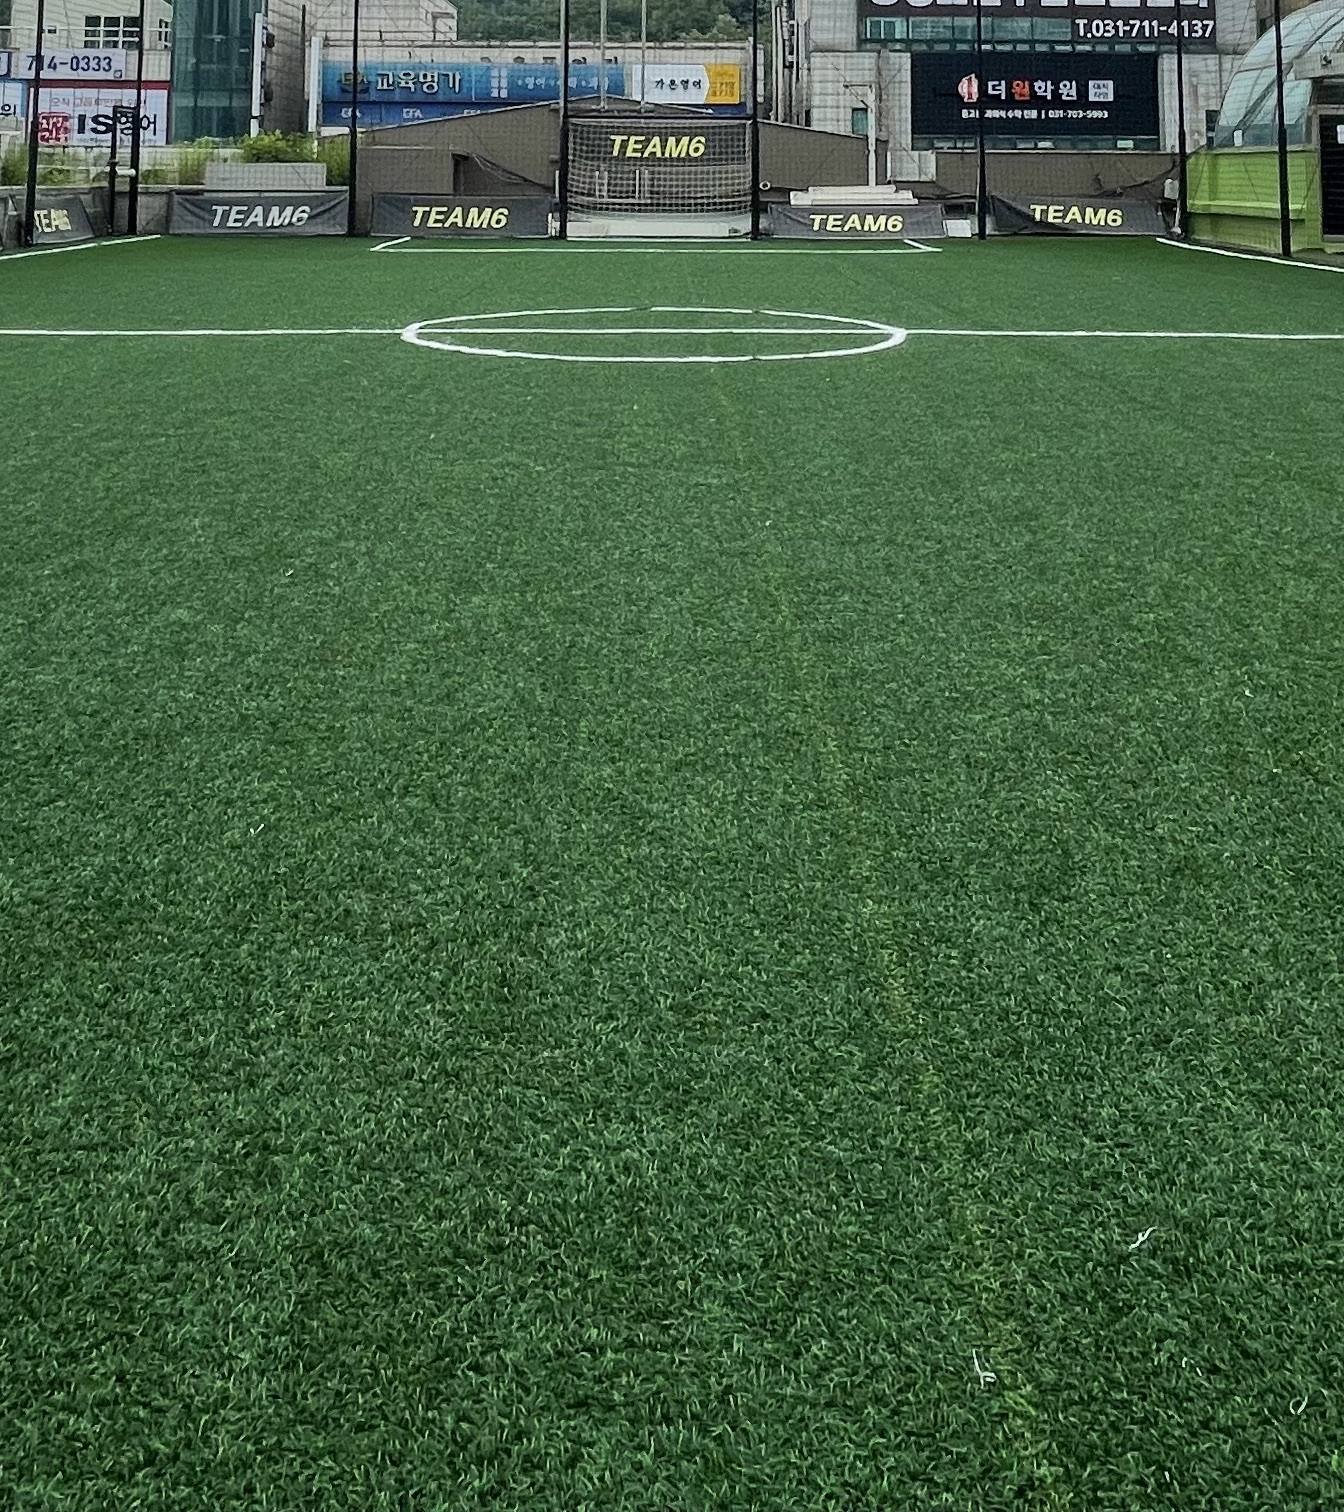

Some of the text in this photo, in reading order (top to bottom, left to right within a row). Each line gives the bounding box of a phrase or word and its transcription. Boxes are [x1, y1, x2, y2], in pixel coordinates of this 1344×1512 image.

[1075, 18, 1215, 39] T.031-711-4137
[376, 71, 462, 94] 교육명가
[609, 134, 707, 159] TEAM6
[211, 205, 311, 229] TEAM6
[411, 205, 509, 230] TEAM6
[809, 213, 904, 234] TEAM6
[1030, 204, 1123, 228] TEAM6
